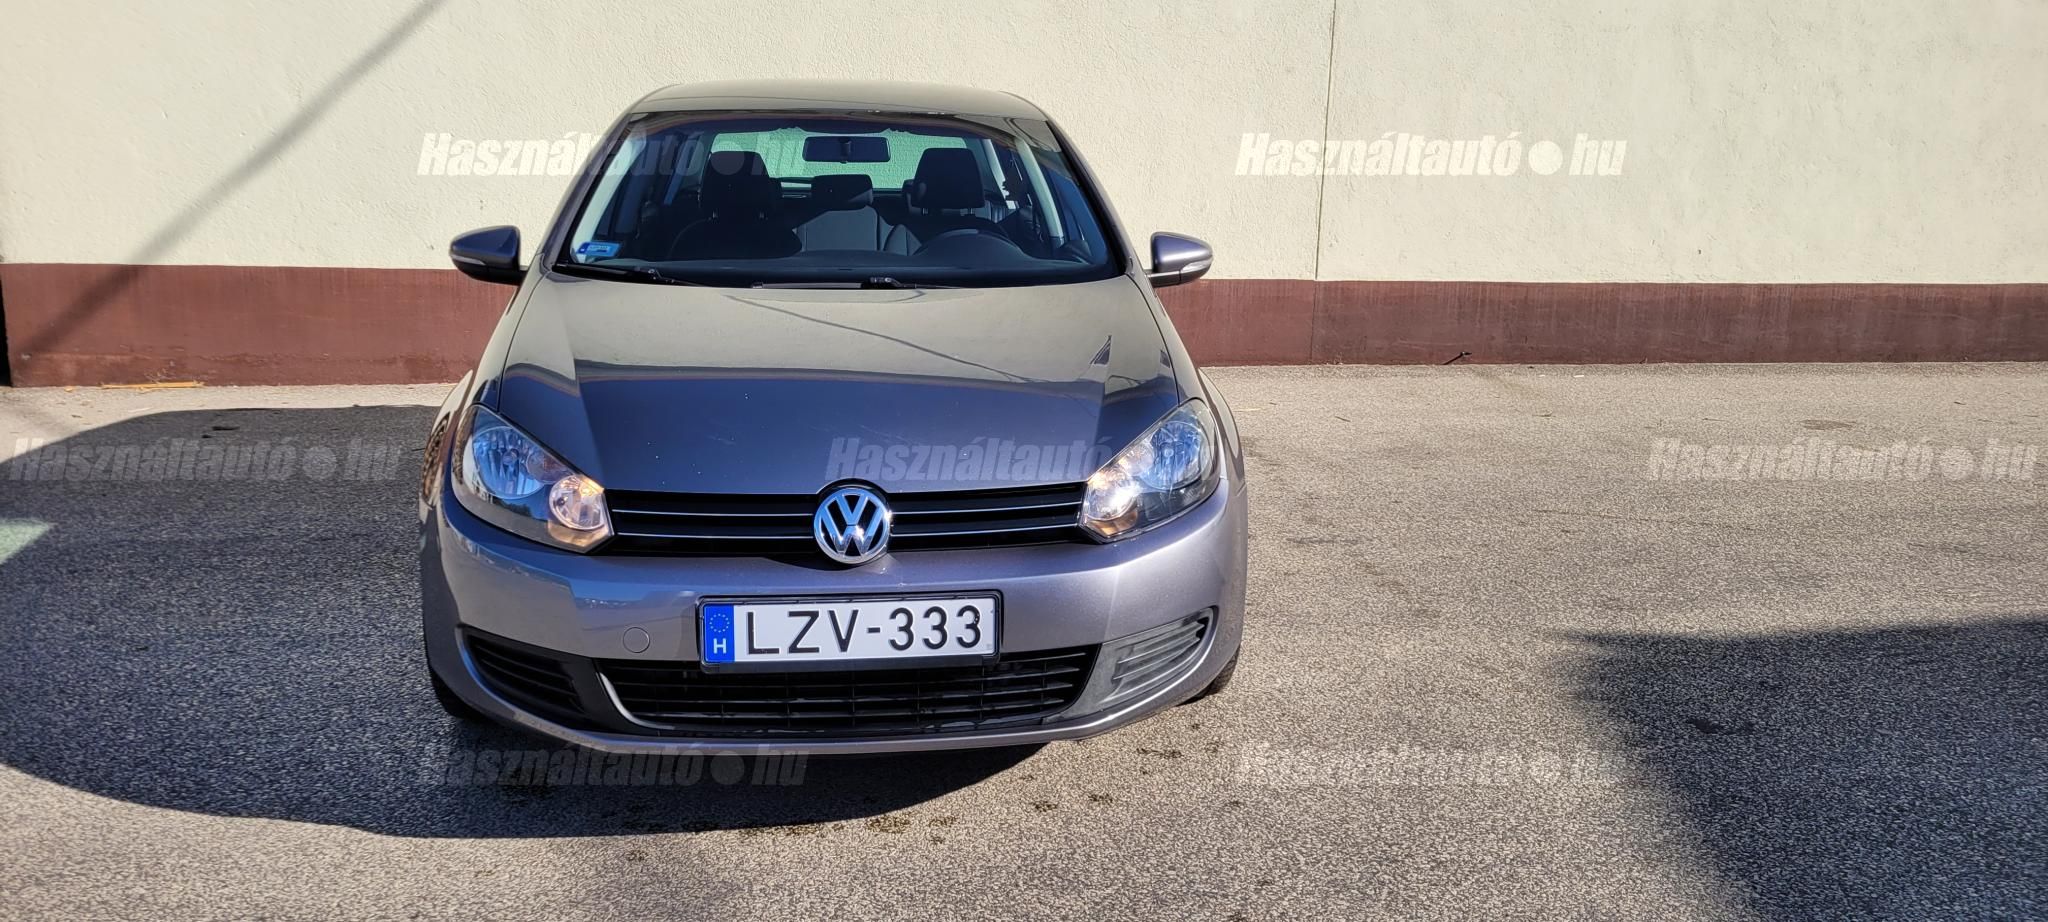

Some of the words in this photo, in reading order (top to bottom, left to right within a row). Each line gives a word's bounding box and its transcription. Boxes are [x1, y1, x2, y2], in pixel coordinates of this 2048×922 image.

[815, 488, 889, 563] VW
[713, 638, 727, 655] H
[747, 605, 981, 655] LZV-333
